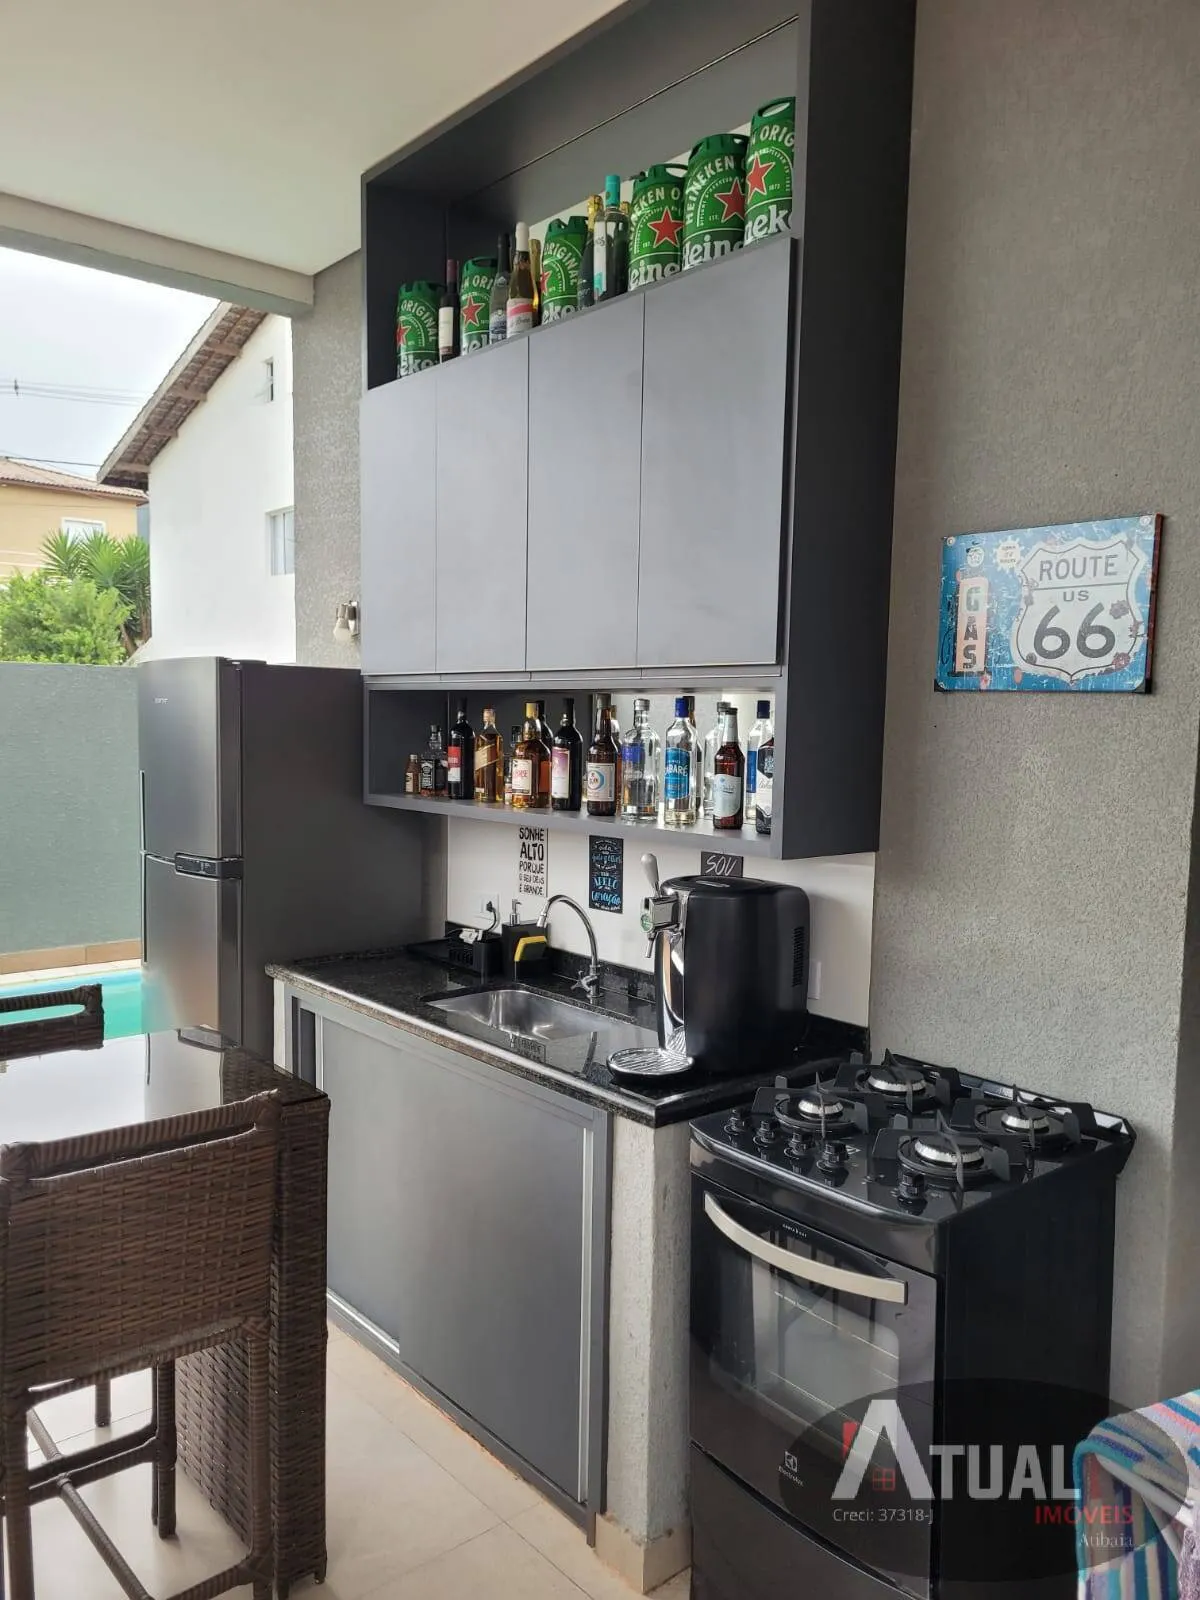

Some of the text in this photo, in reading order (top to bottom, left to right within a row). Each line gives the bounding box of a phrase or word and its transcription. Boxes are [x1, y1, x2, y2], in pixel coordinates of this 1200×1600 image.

[686, 156, 734, 225] HEINEKEN
[401, 299, 437, 342] ORIGINAL
[1039, 554, 1118, 582] ROUTE
[1063, 590, 1090, 602] US
[963, 585, 981, 669] GAS
[1033, 602, 1116, 660] 66
[519, 827, 545, 841] SONHE
[520, 841, 544, 861] ALTO
[519, 861, 545, 874] PORQUE
